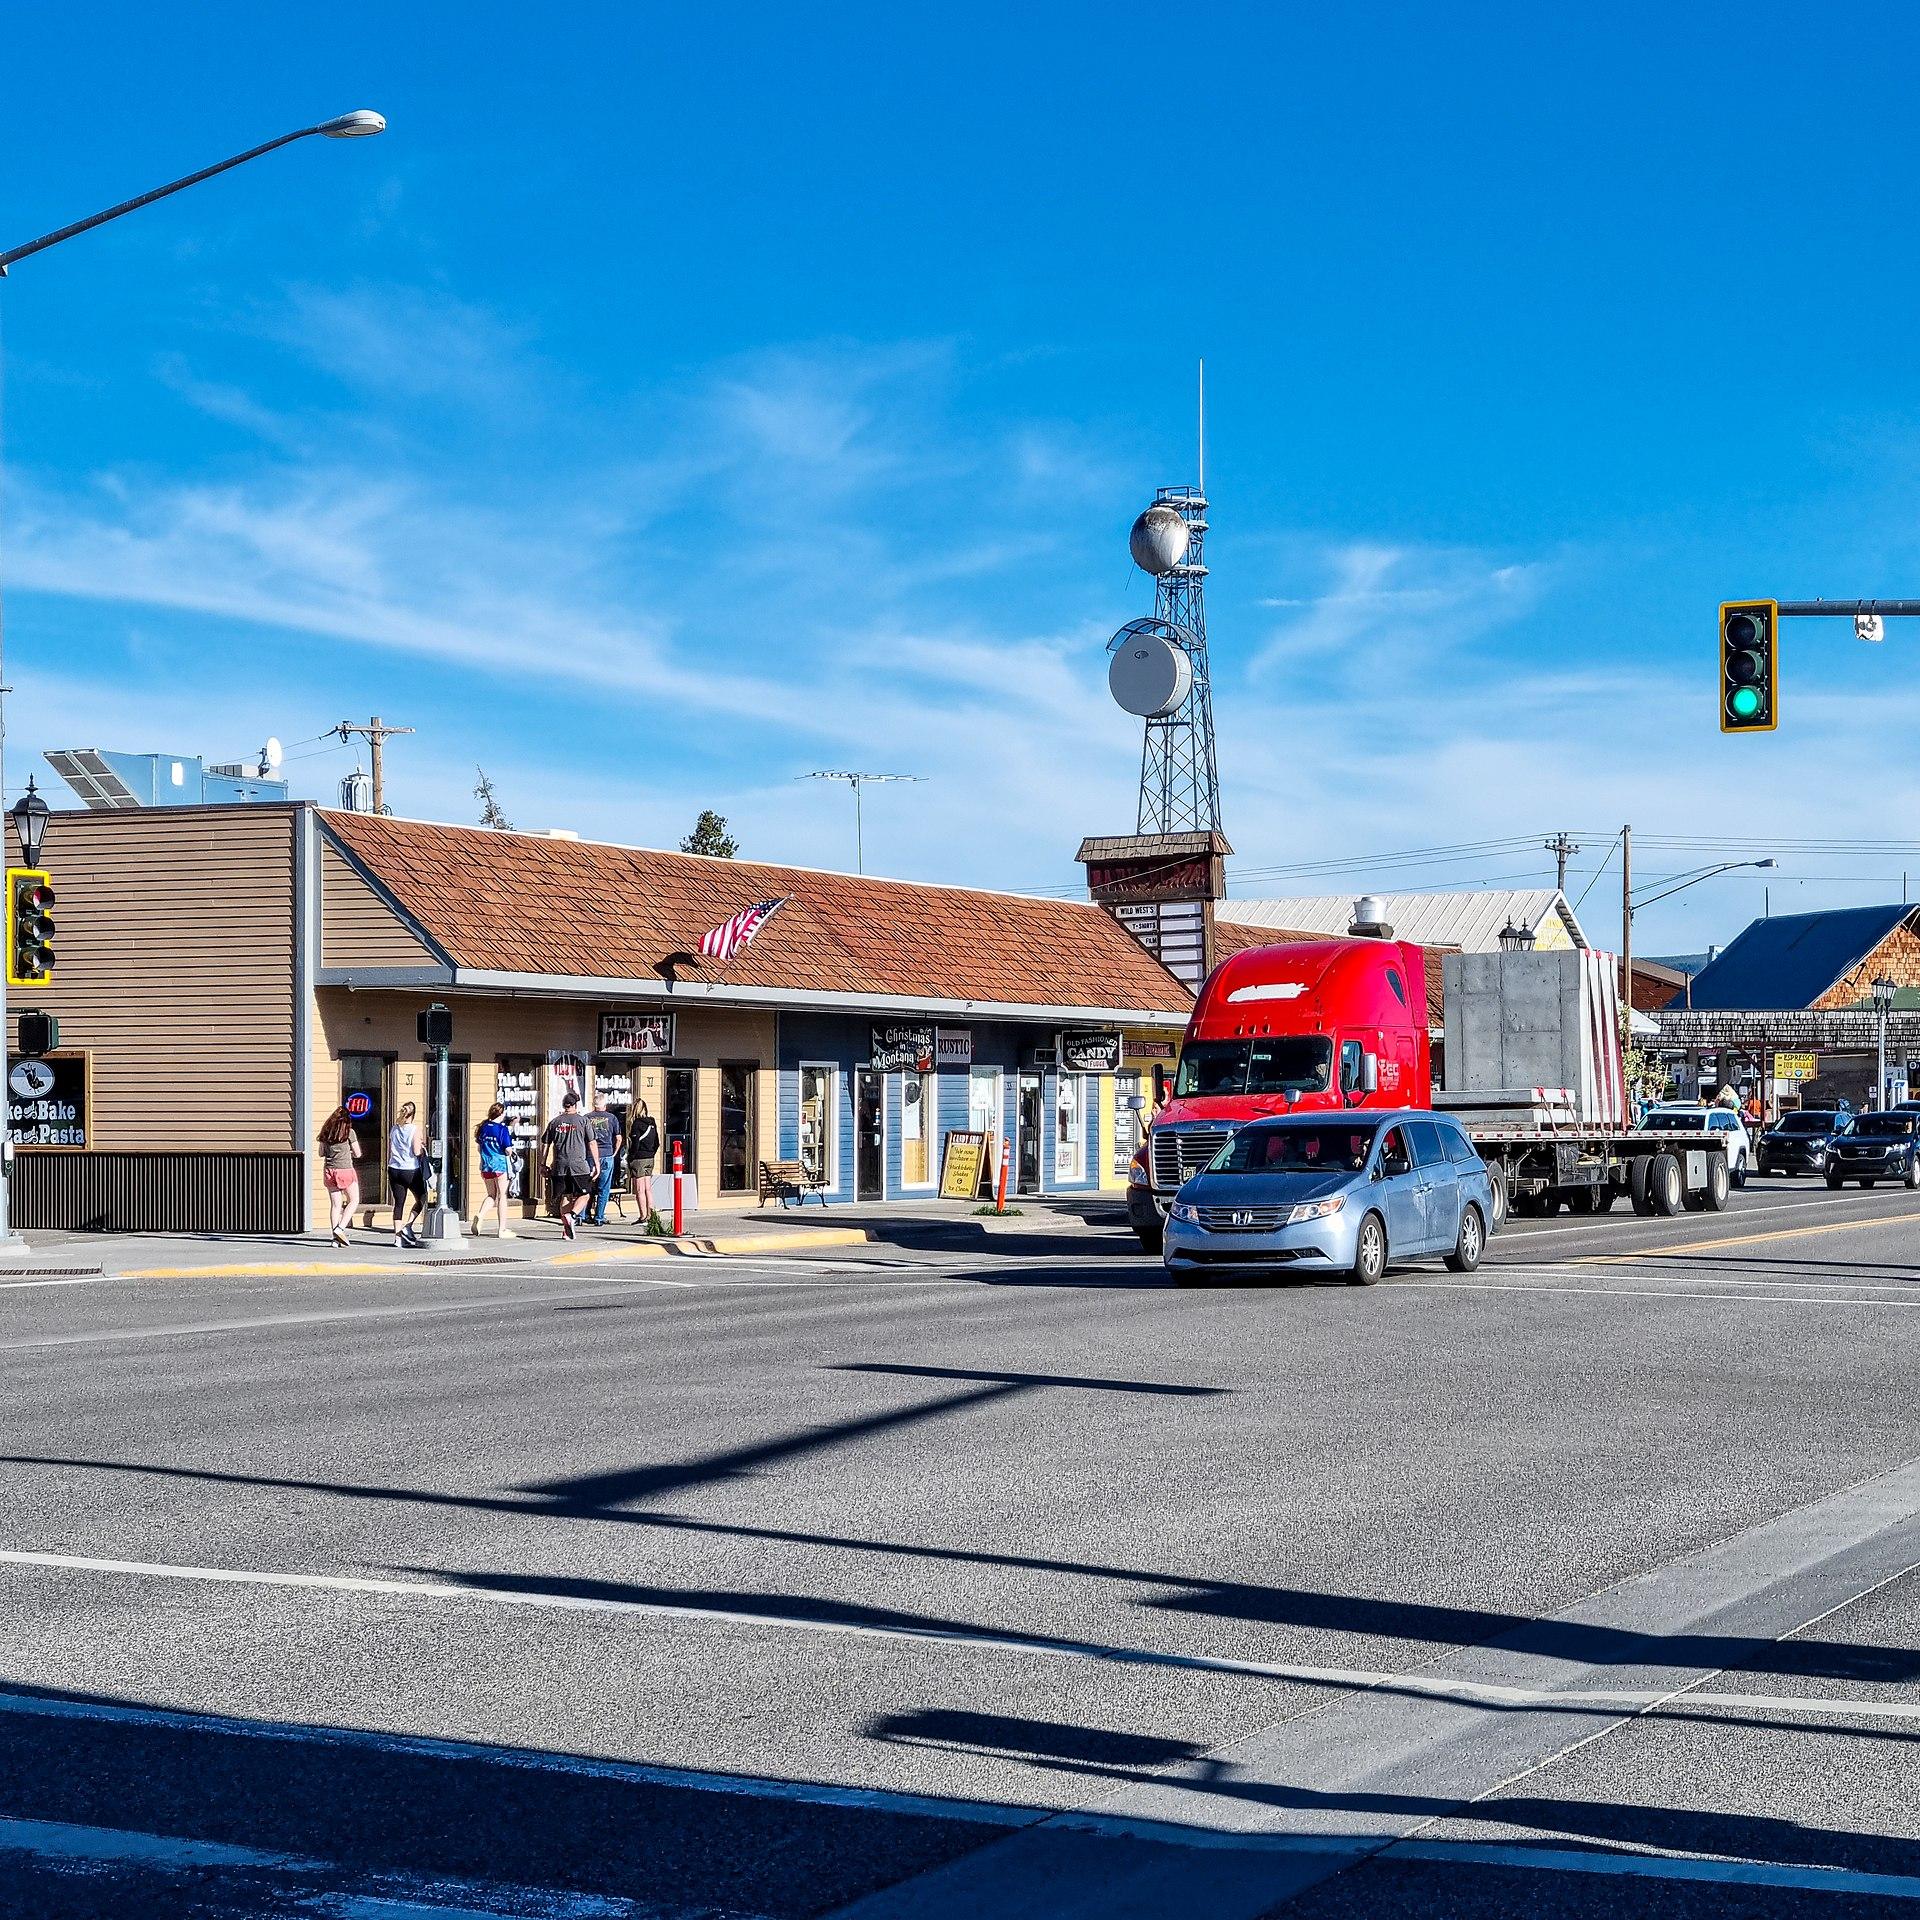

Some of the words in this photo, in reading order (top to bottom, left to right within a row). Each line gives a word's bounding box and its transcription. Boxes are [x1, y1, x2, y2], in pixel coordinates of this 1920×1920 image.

[1135, 905, 1154, 914] WEST'S
[606, 1017, 635, 1028] WILD
[605, 1030, 648, 1050] EXPRESS
[885, 1028, 930, 1045] Christmas
[1066, 1039, 1081, 1047] OLD
[938, 1039, 970, 1055] RUSTIC
[1067, 1047, 1116, 1059] CANDY
[872, 1050, 914, 1070] Montana
[1089, 1060, 1106, 1068] FUDGE
[497, 1073, 517, 1087] Take
[518, 1072, 533, 1087] Out
[504, 1087, 537, 1105] Delivery
[6, 1100, 23, 1120] ke
[37, 1100, 76, 1120] Bake
[38, 1124, 85, 1144] Pasta
